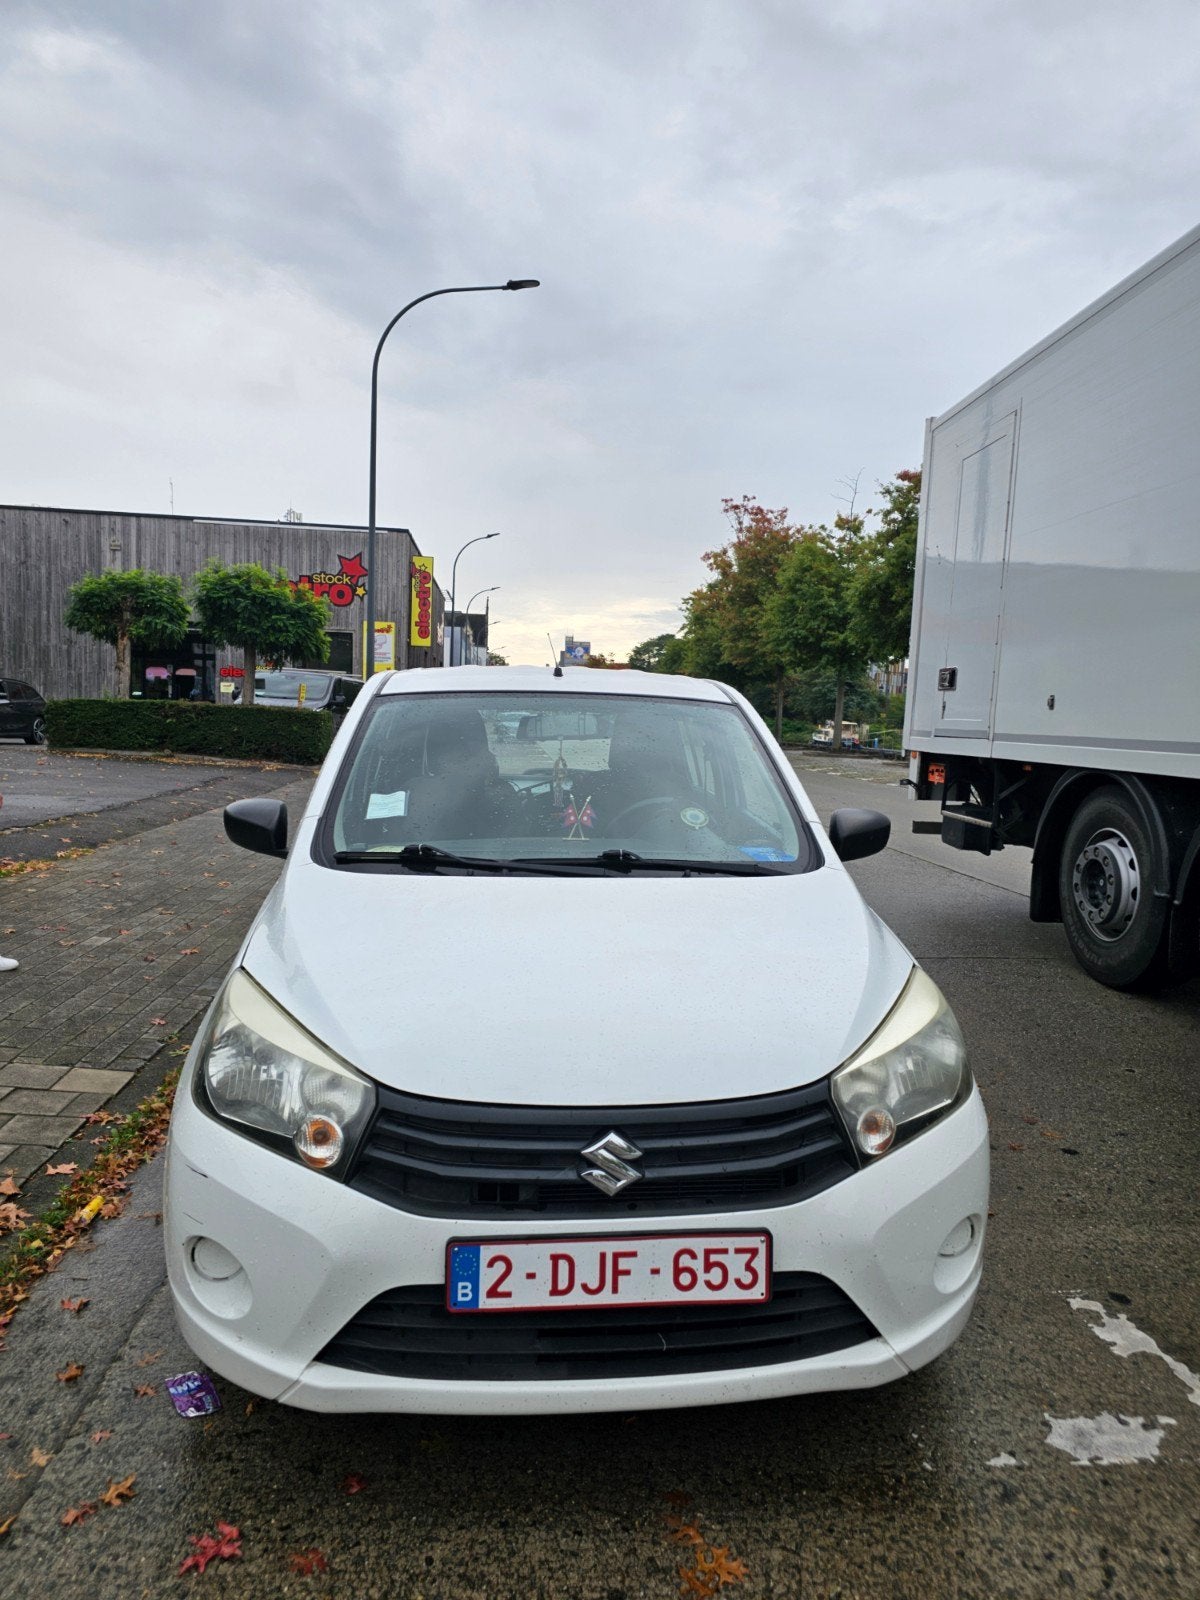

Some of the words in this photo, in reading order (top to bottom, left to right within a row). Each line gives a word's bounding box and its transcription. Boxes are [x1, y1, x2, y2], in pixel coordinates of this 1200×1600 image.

[312, 573, 351, 584] stock
[415, 571, 431, 639] electro
[457, 1282, 472, 1301] B
[486, 1248, 759, 1298] 2-DJF-653
